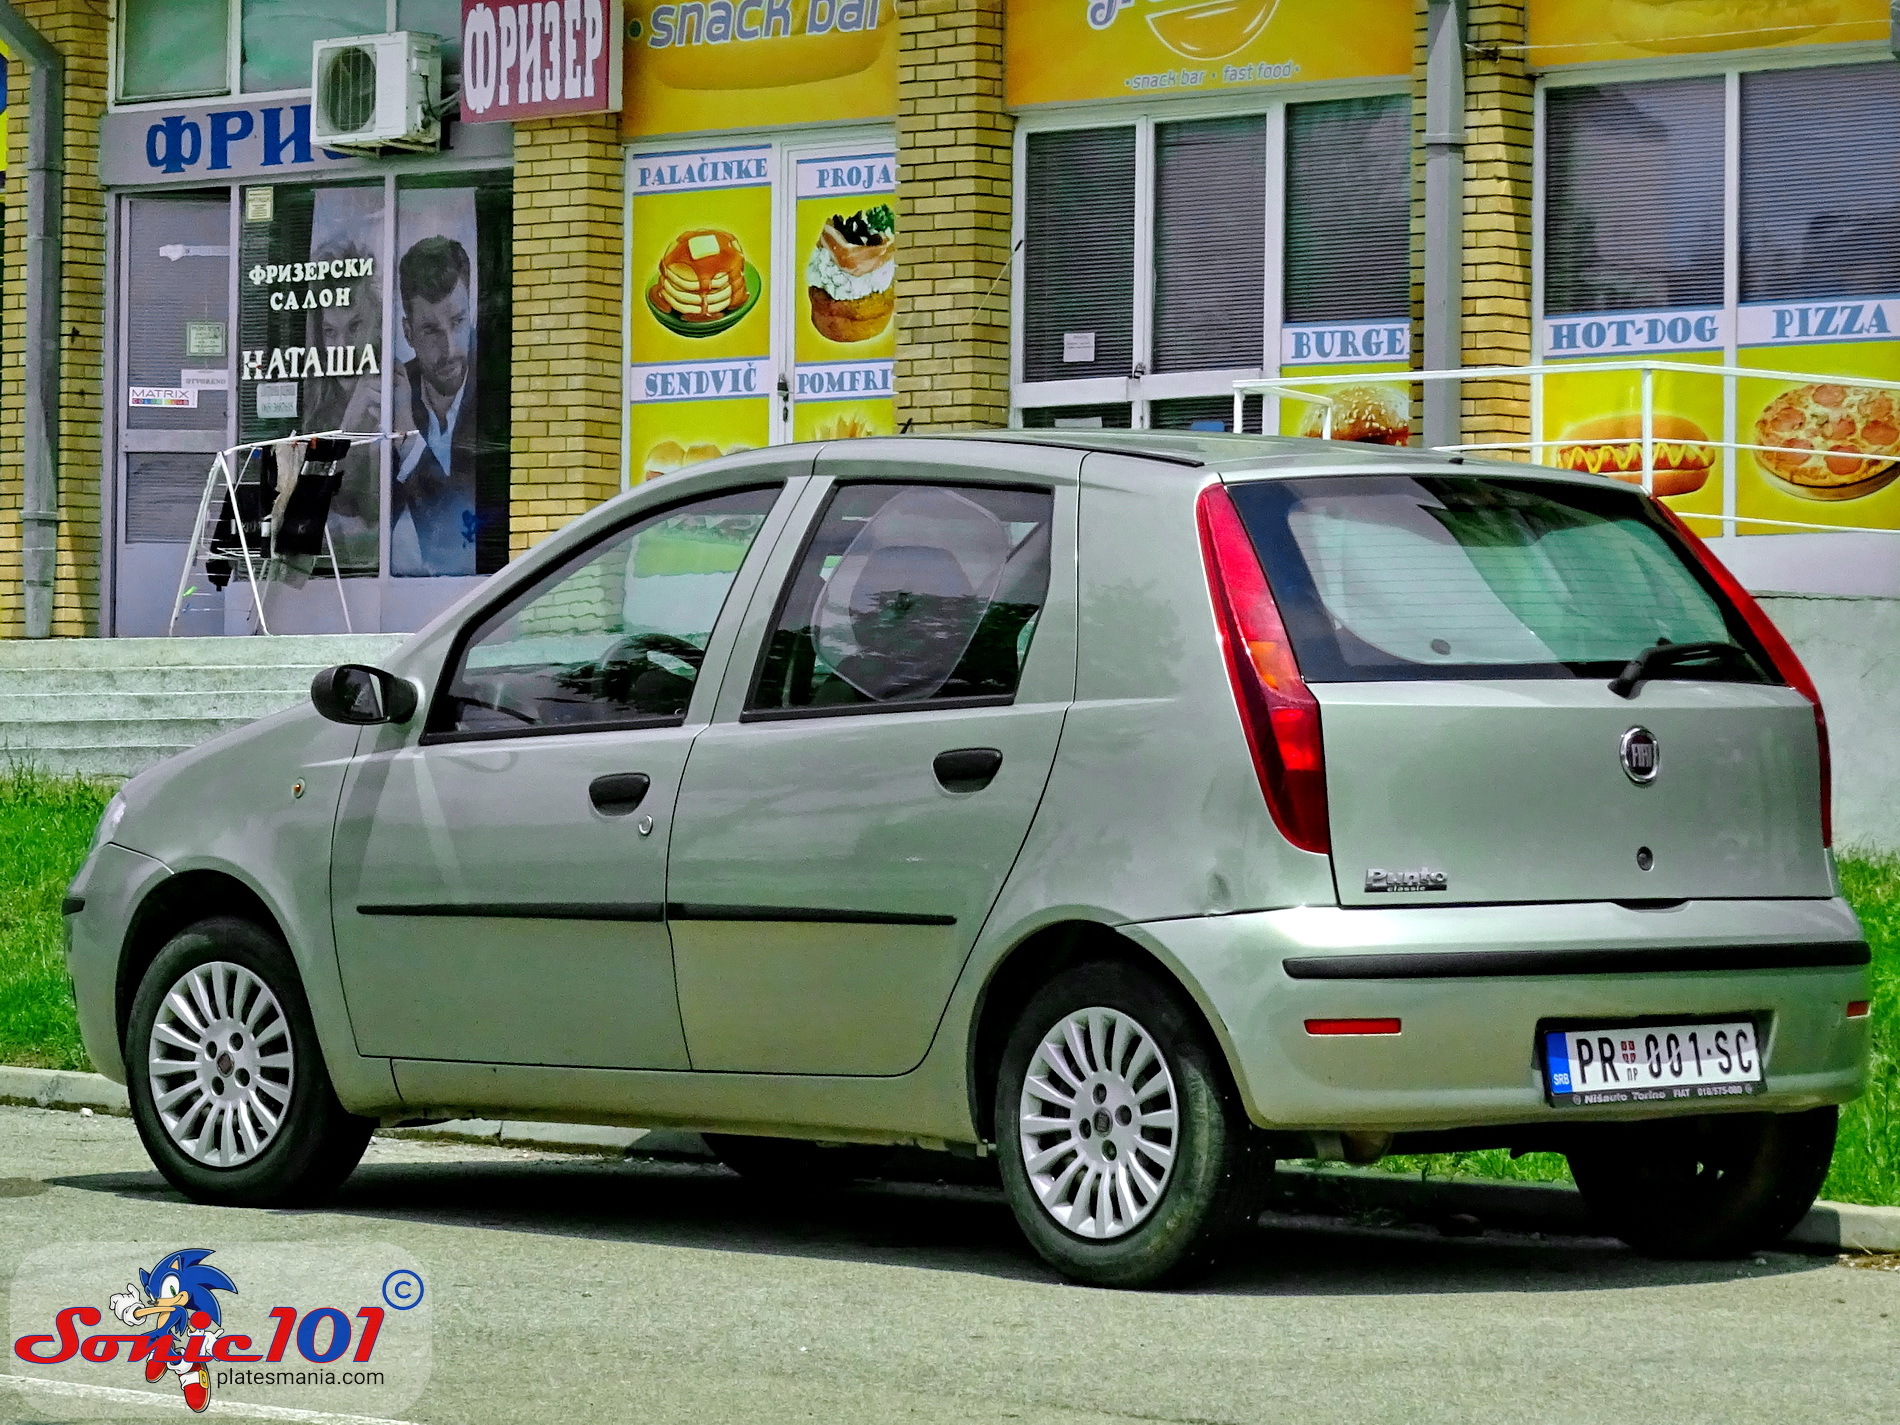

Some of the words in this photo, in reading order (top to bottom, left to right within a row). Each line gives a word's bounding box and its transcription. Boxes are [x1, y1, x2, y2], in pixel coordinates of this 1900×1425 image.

[648, 0, 791, 48] snack
[463, 0, 603, 114] ФРИЗЕР
[1131, 69, 1176, 89] snack
[1180, 69, 1205, 85] bar
[1223, 62, 1253, 82] fast
[1257, 60, 1293, 79] food
[146, 104, 352, 174] ФРИ
[638, 157, 767, 187] PALAČINKE
[816, 164, 892, 188] PROJA
[249, 258, 373, 285] ФРИЗЕРСКИ
[270, 288, 350, 310] САЛОН
[1550, 315, 1718, 351] HOT-DOG
[1771, 304, 1890, 340] PIZZA
[1291, 327, 1409, 360] BURGE
[242, 343, 380, 380] НАТАША
[132, 388, 190, 399] MATRIX
[645, 362, 757, 397] SENDVIČ
[797, 368, 892, 395] POMFRI
[1367, 867, 1448, 885] Punto
[1576, 1037, 1620, 1084] PR
[1553, 1073, 1570, 1085] SRB
[1631, 1090, 1666, 1101] Torino
